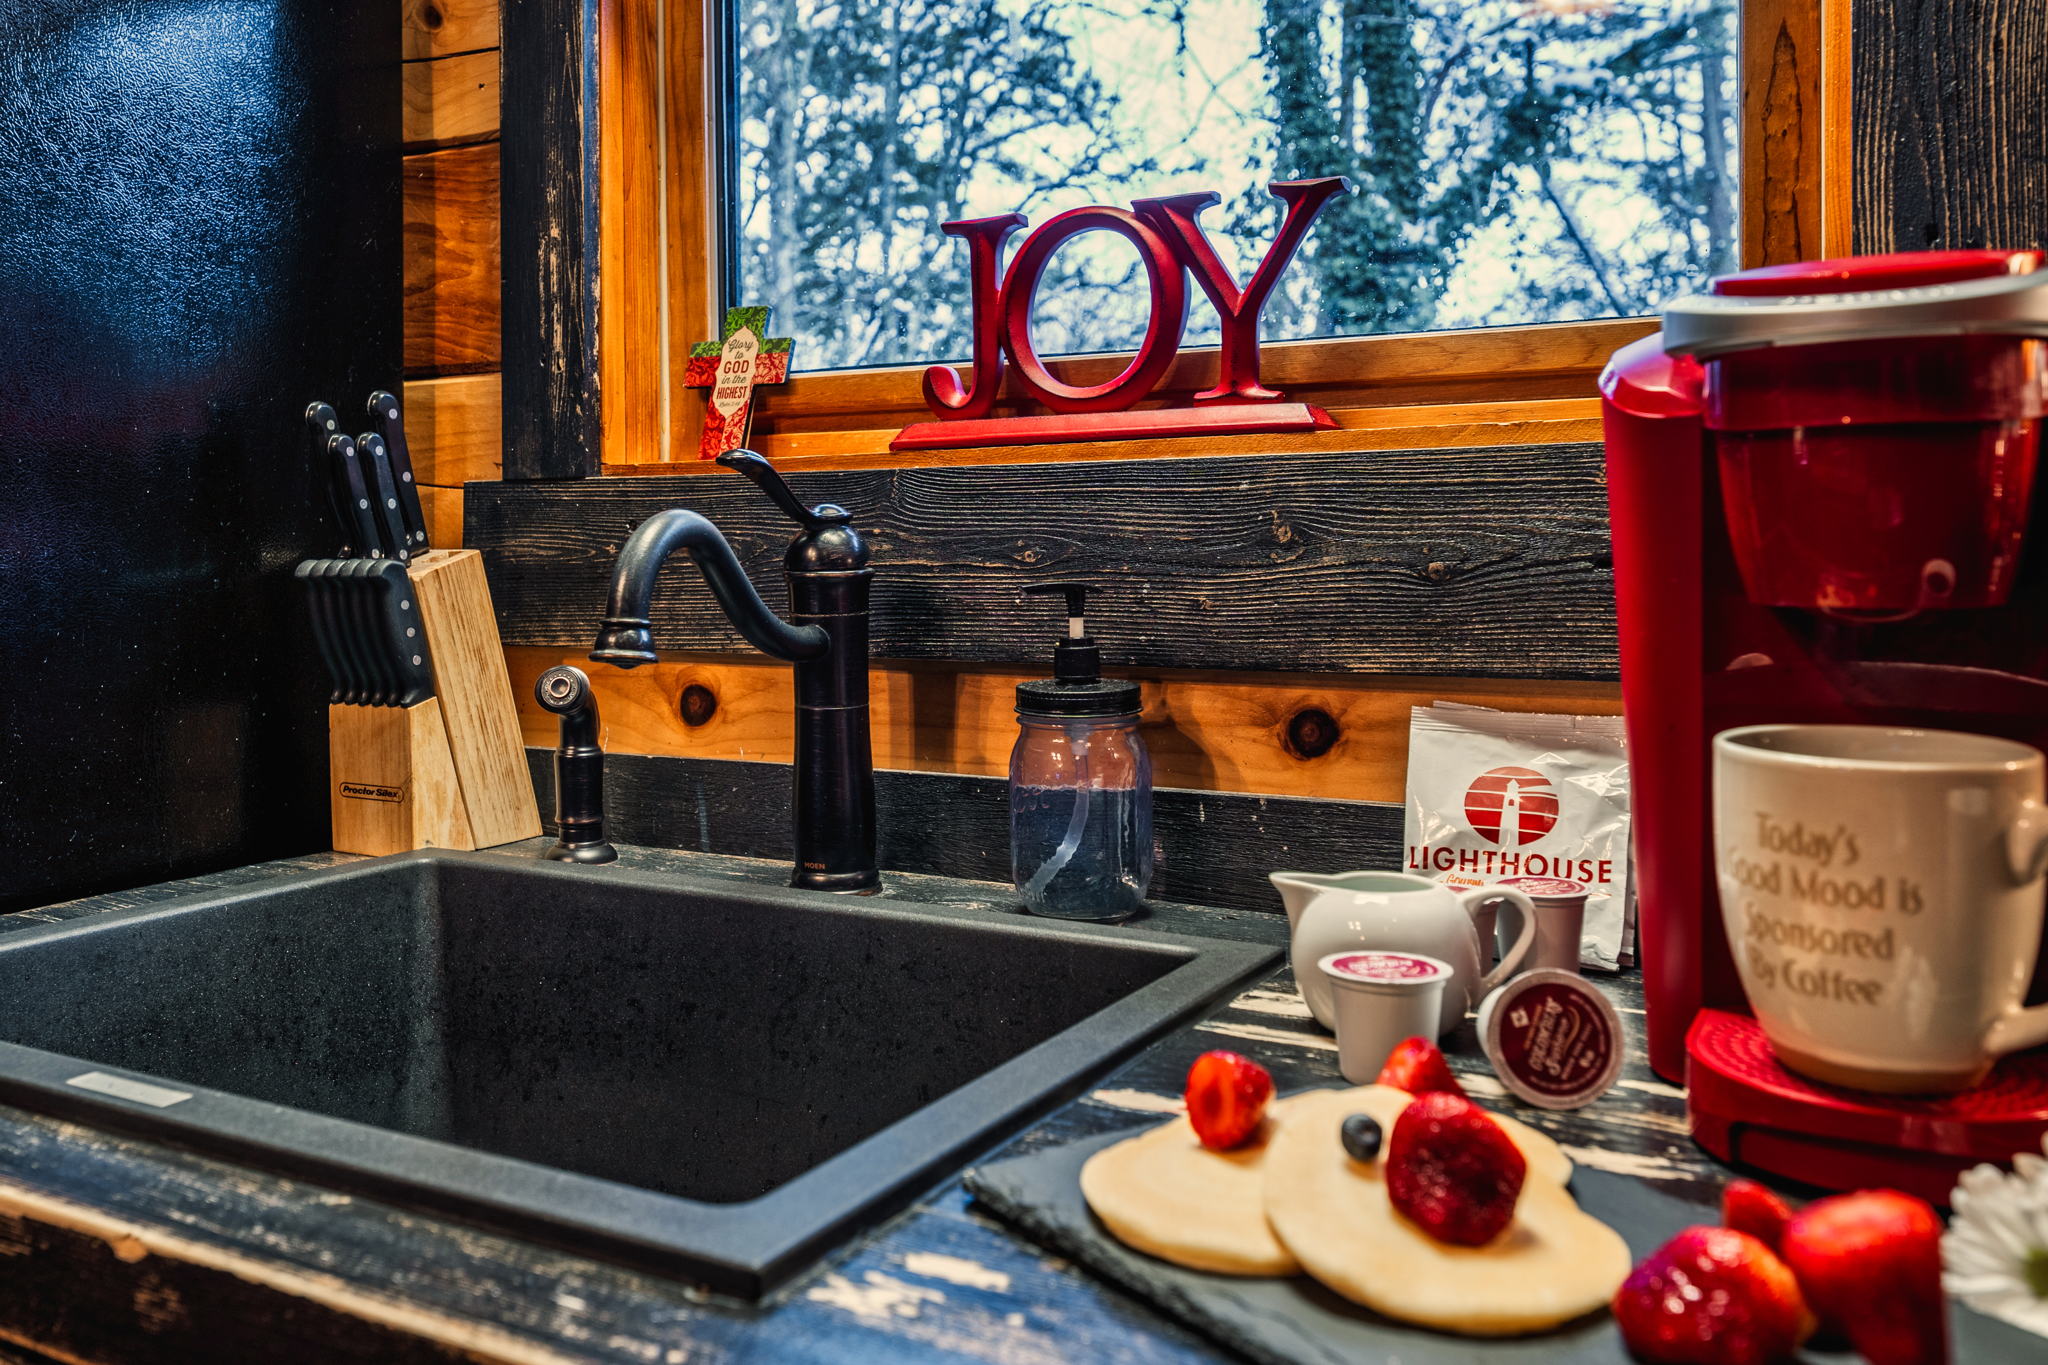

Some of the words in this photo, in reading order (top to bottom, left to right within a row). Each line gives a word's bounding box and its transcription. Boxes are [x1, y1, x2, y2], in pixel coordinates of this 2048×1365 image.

[922, 176, 1351, 421] JOY
[728, 338, 753, 353] Glory
[734, 350, 744, 360] to
[723, 360, 750, 374] GOD
[721, 375, 731, 385] in
[732, 374, 747, 384] the
[716, 385, 748, 400] HIGHEST
[343, 785, 375, 795] Proctor
[1755, 811, 1860, 867] Today's
[804, 862, 826, 870] MOEN
[1408, 846, 1613, 884] LIGHTHOUSE
[1790, 866, 1886, 911] Mood
[1746, 902, 1895, 961] Sponsored
[1749, 946, 1776, 990] By
[1782, 959, 1884, 1006] Coffee
